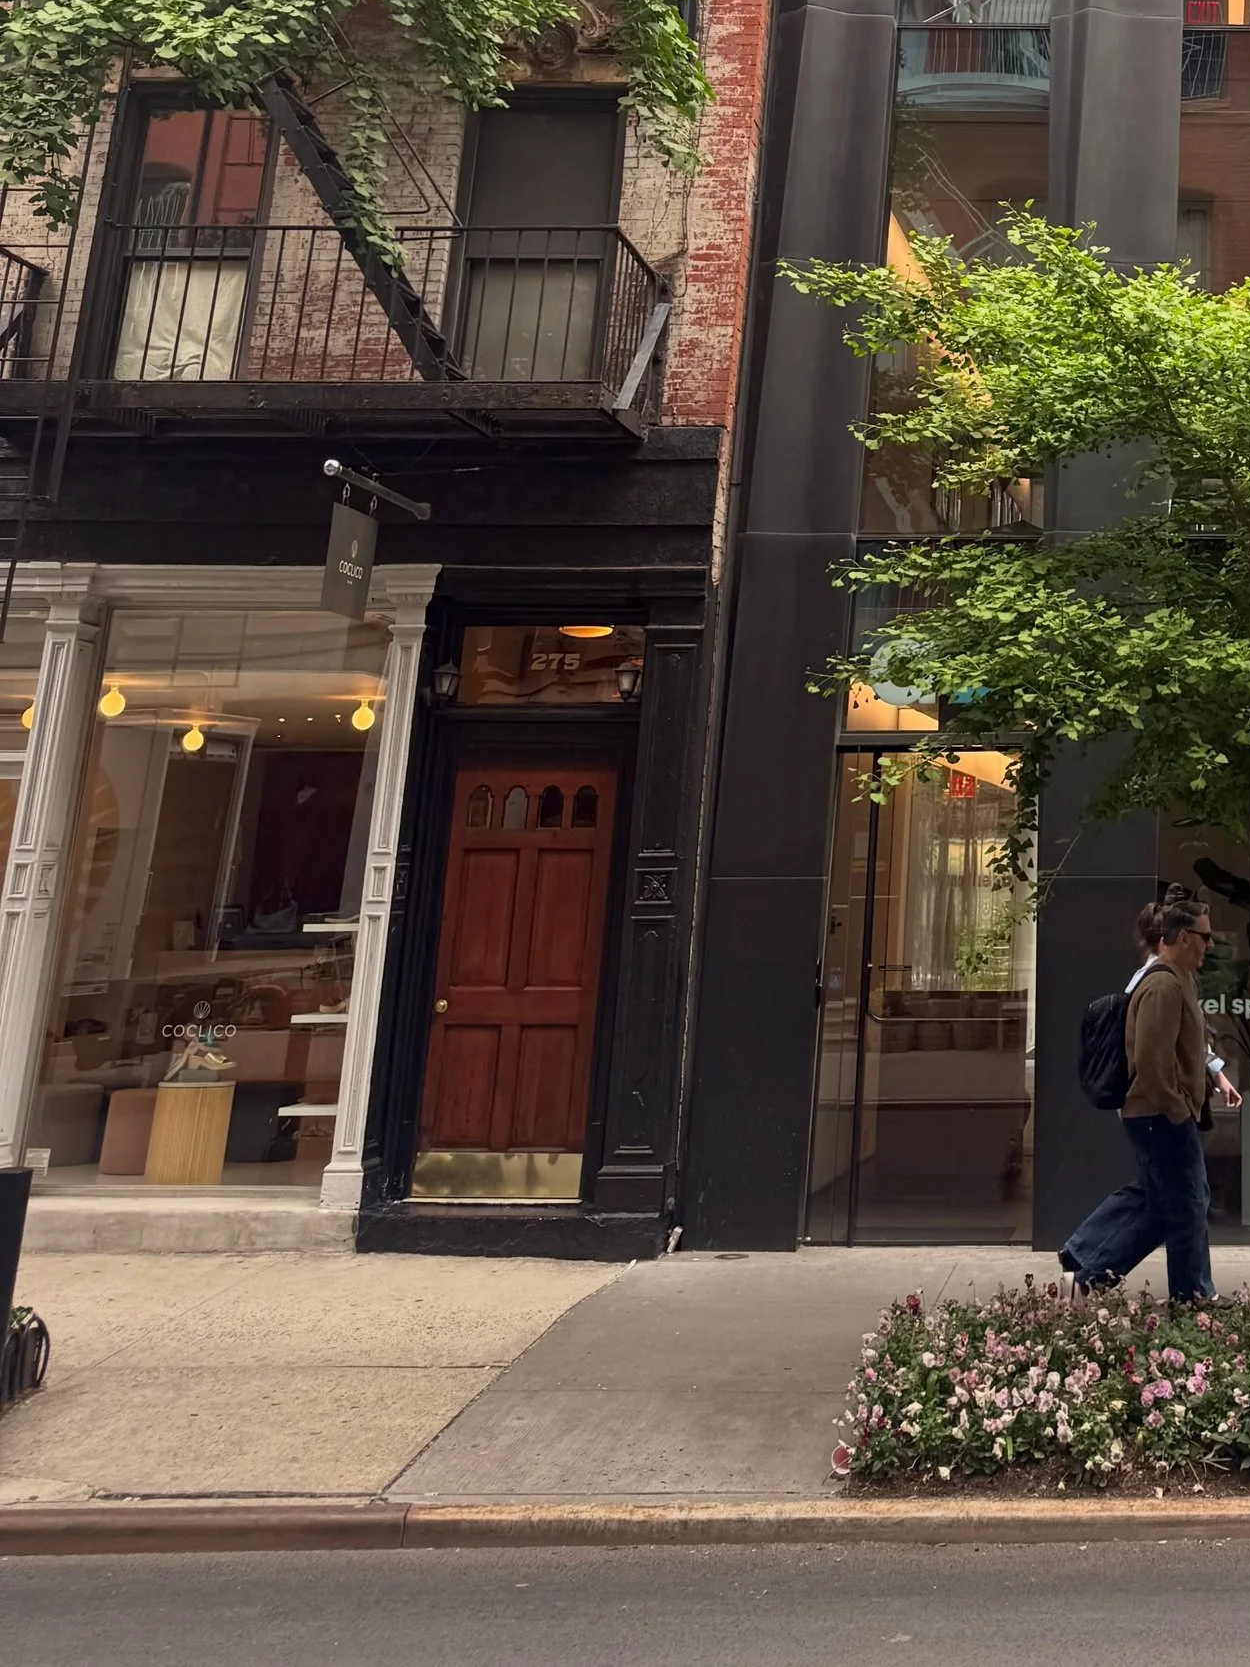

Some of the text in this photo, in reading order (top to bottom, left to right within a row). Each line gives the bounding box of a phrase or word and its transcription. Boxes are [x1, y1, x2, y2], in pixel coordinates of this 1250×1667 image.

[1187, 0, 1219, 23] EXIT
[339, 560, 363, 580] COCLICO
[530, 653, 581, 671] 275
[162, 1024, 237, 1038] COCLICO
